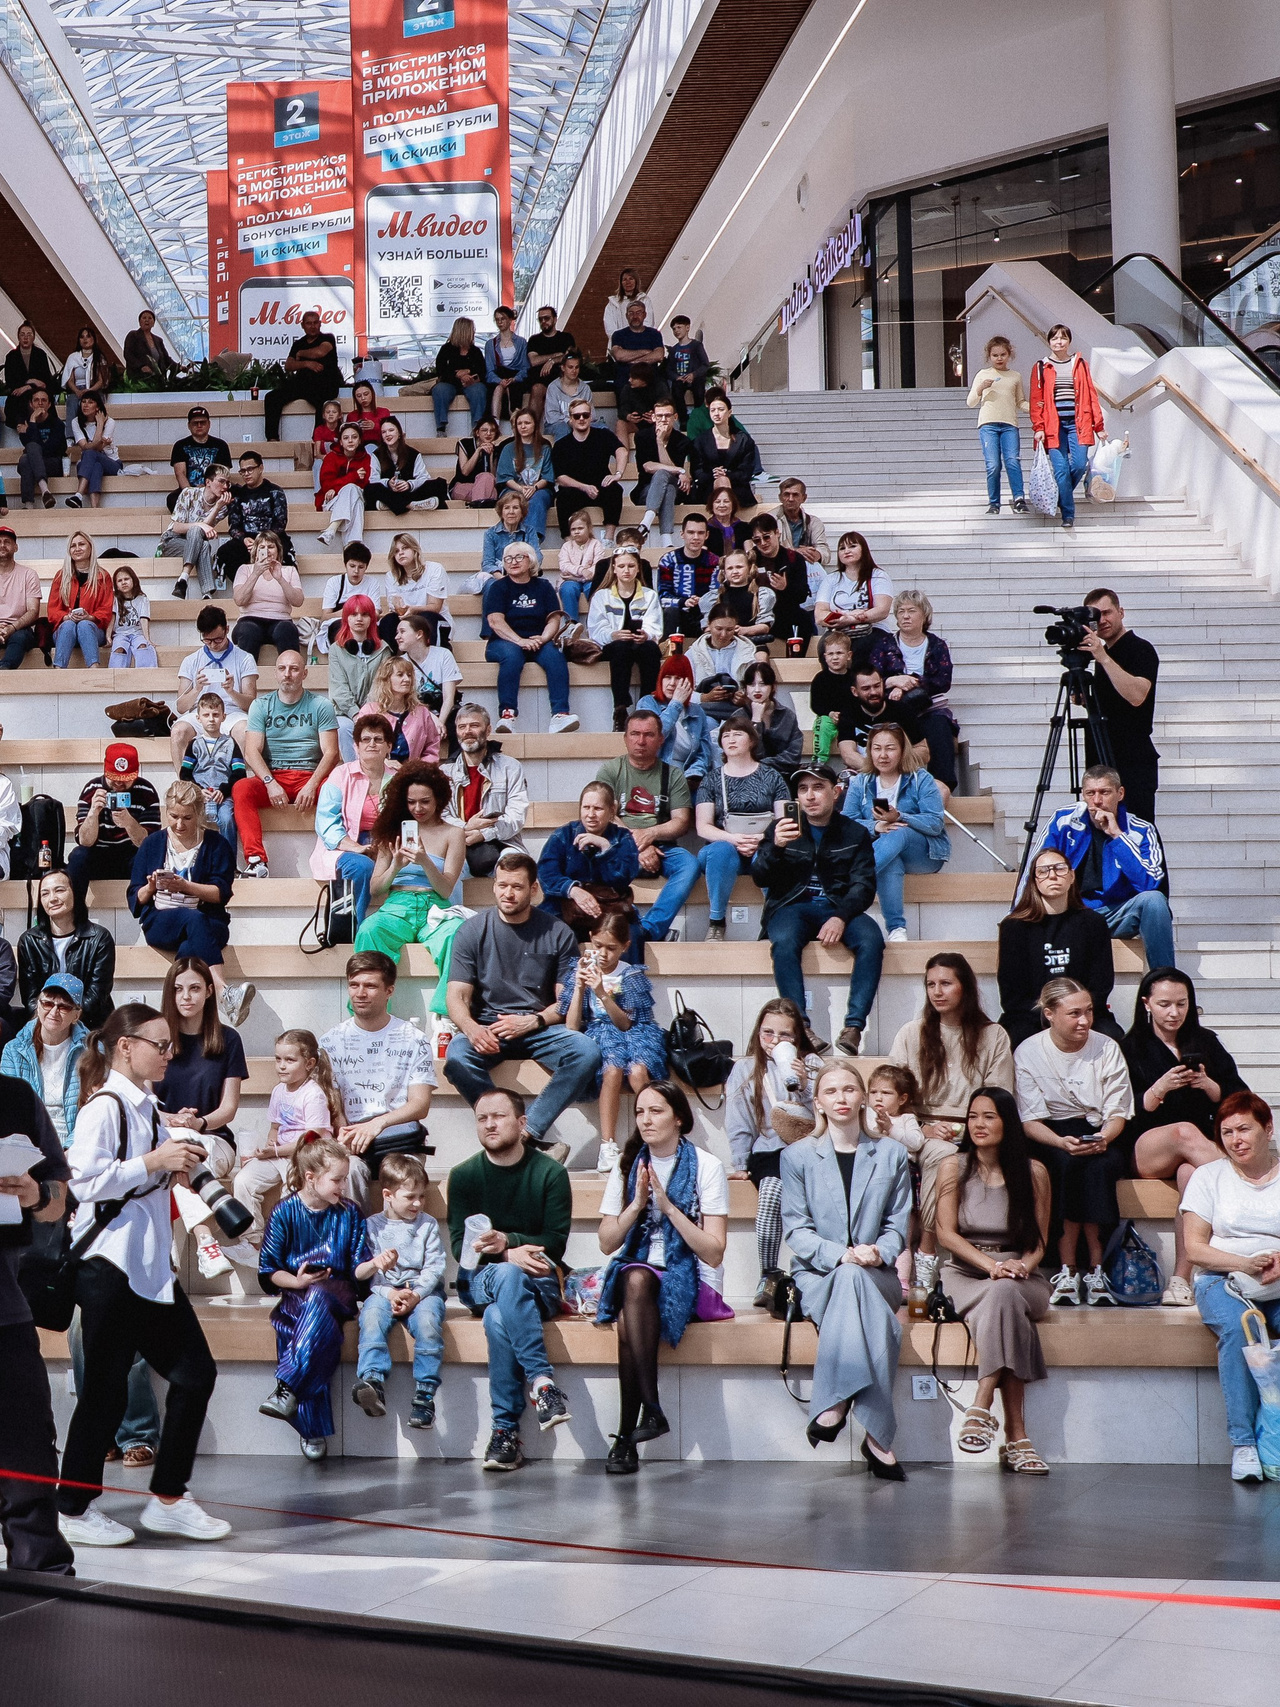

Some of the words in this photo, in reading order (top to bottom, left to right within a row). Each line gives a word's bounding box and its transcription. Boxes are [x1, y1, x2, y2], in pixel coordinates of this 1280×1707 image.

[412, 18, 444, 31] этаж
[362, 43, 486, 77] РЕГИСТРИРУЙСЯ
[362, 80, 373, 92] В
[377, 56, 486, 88] МОБИЛЬНОМ
[362, 70, 487, 105] ПРИЛОЖЕНИИ
[286, 99, 306, 126] 2
[373, 99, 448, 126] ПОЛУЧАЙ
[282, 130, 311, 142] этаж
[369, 122, 444, 145] БОНУСНЫЕ
[447, 113, 492, 130] РУБЛИ
[389, 152, 399, 163] И
[402, 141, 457, 160] СКИДКИ
[237, 154, 347, 182] РЕГИСТРИРУЙСЯ
[237, 184, 247, 195] В
[250, 165, 347, 193] МОБИЛЬНОМ
[237, 177, 347, 207] ПРИЛОЖЕНИИ
[246, 202, 313, 226] ПОЛУЧАЙ
[377, 210, 488, 239] М.видео
[243, 222, 309, 243] БОНУСНЫЕ
[311, 215, 352, 231] РУБЛИ
[260, 249, 269, 259] И
[271, 240, 320, 257] СКИДКИ
[377, 247, 423, 261] УЗНАЙ
[426, 248, 488, 260] БОЛЬШЕ!
[814, 213, 862, 294] бейкери
[446, 282, 470, 290] Google
[471, 281, 485, 289] Play
[448, 306, 463, 314] App
[249, 334, 289, 346] УЗНАЙ
[512, 598, 537, 606] PARIS
